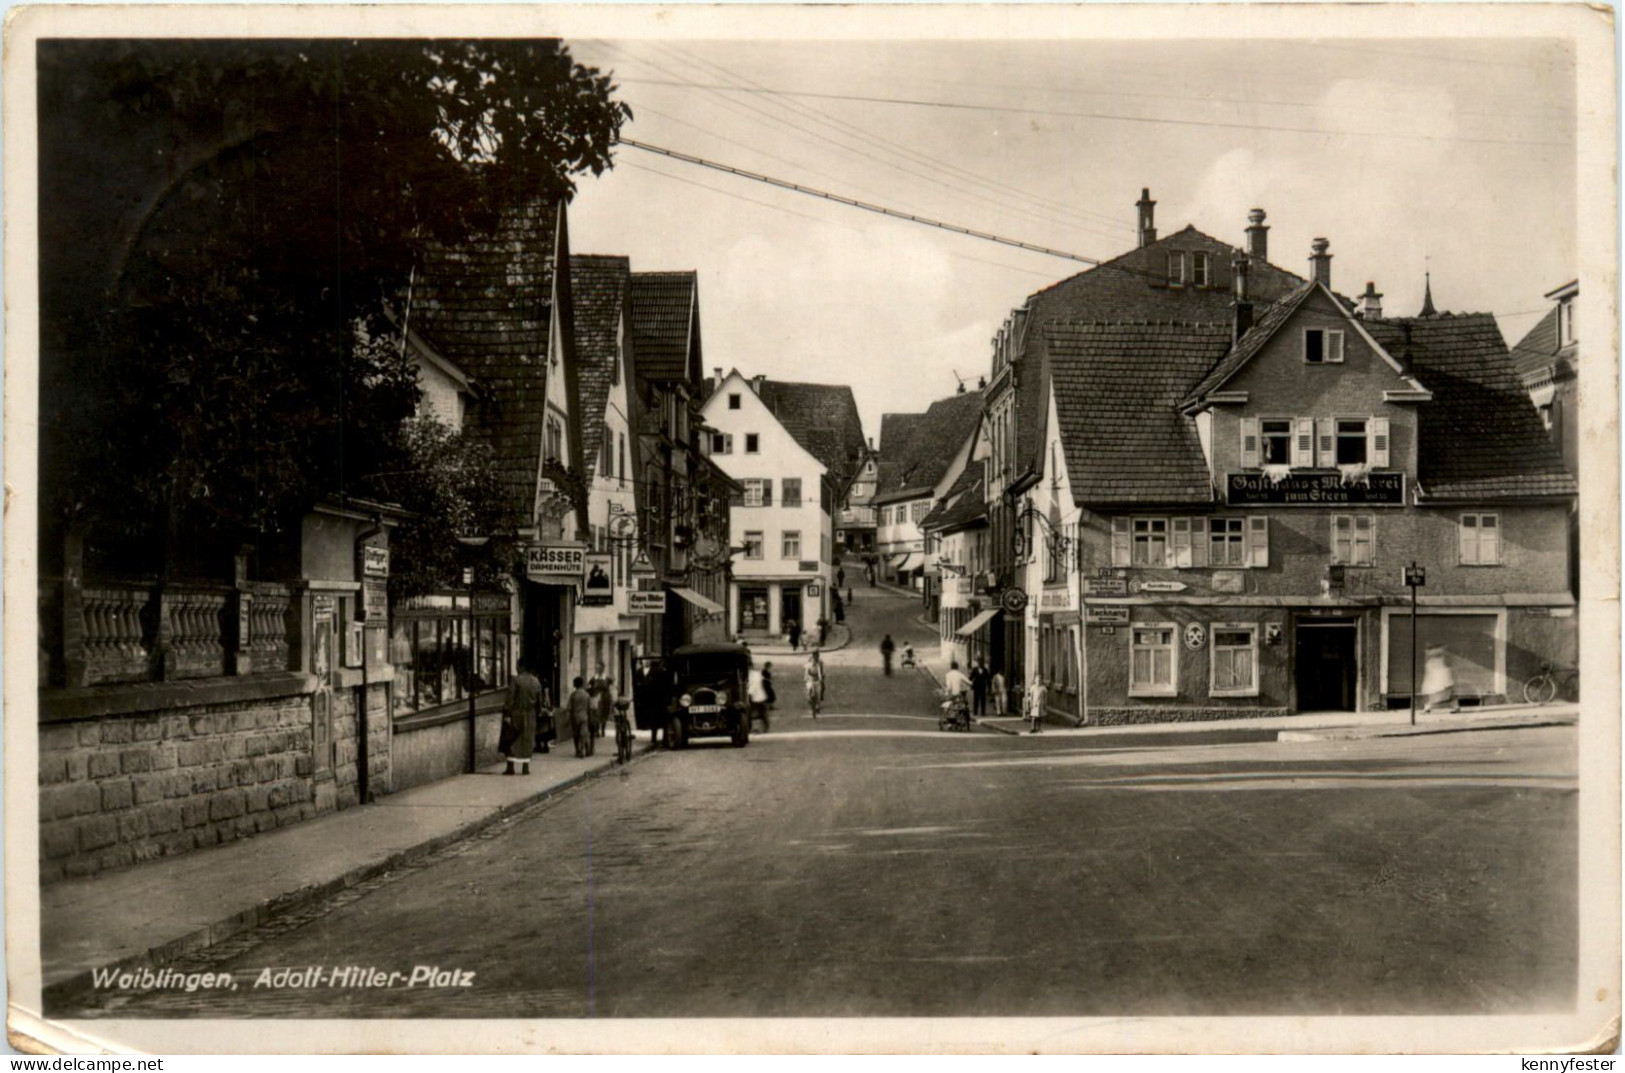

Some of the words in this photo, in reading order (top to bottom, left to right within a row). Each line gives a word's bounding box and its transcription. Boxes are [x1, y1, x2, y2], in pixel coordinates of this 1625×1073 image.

[530, 548, 582, 562] KÄSSER
[530, 562, 581, 572] DAMENHÜTE
[1088, 607, 1127, 618] Backnang
